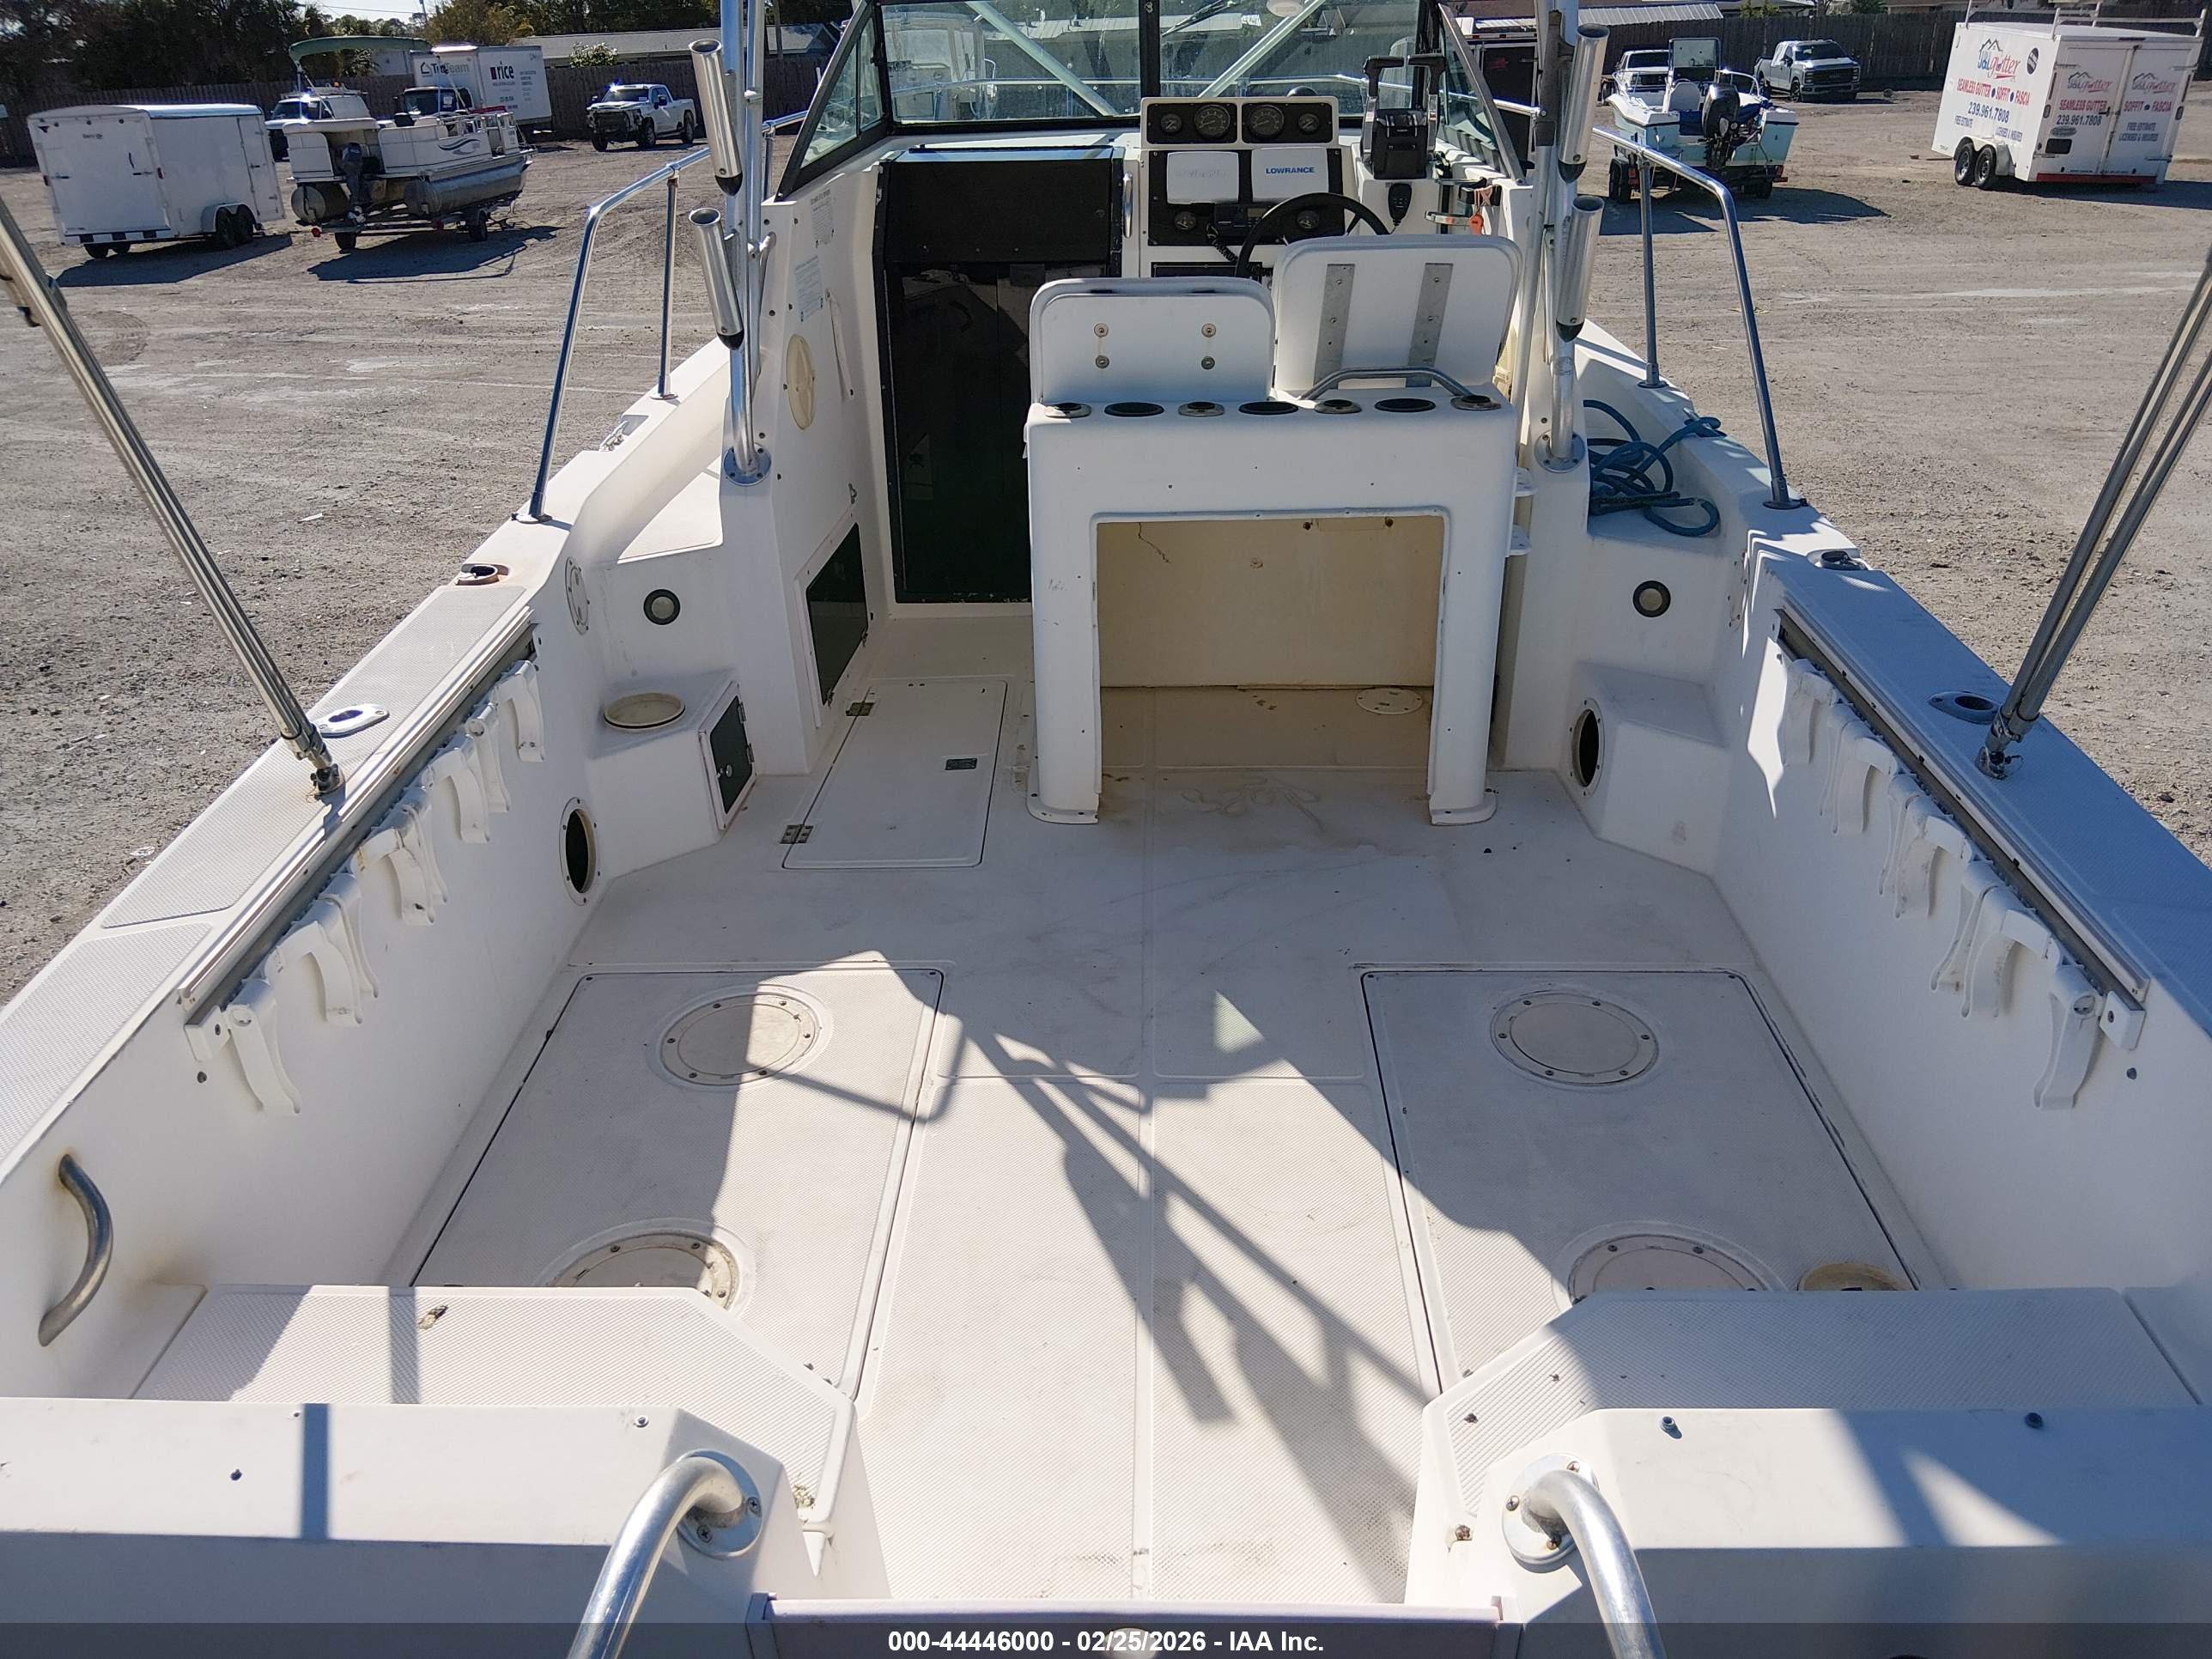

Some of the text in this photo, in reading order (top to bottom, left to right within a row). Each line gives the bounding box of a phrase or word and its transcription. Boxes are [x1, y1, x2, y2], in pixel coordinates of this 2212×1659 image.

[1957, 78, 2031, 106] SEAMLESS GUTTER SOFFIT FASCIA
[2060, 100, 2107, 111] SEAMLESS GUTTER
[2123, 100, 2172, 112] SOFFIT FASCIA
[1968, 101, 2009, 123] 239.961.7808
[2056, 114, 2102, 125] 239.961.7808
